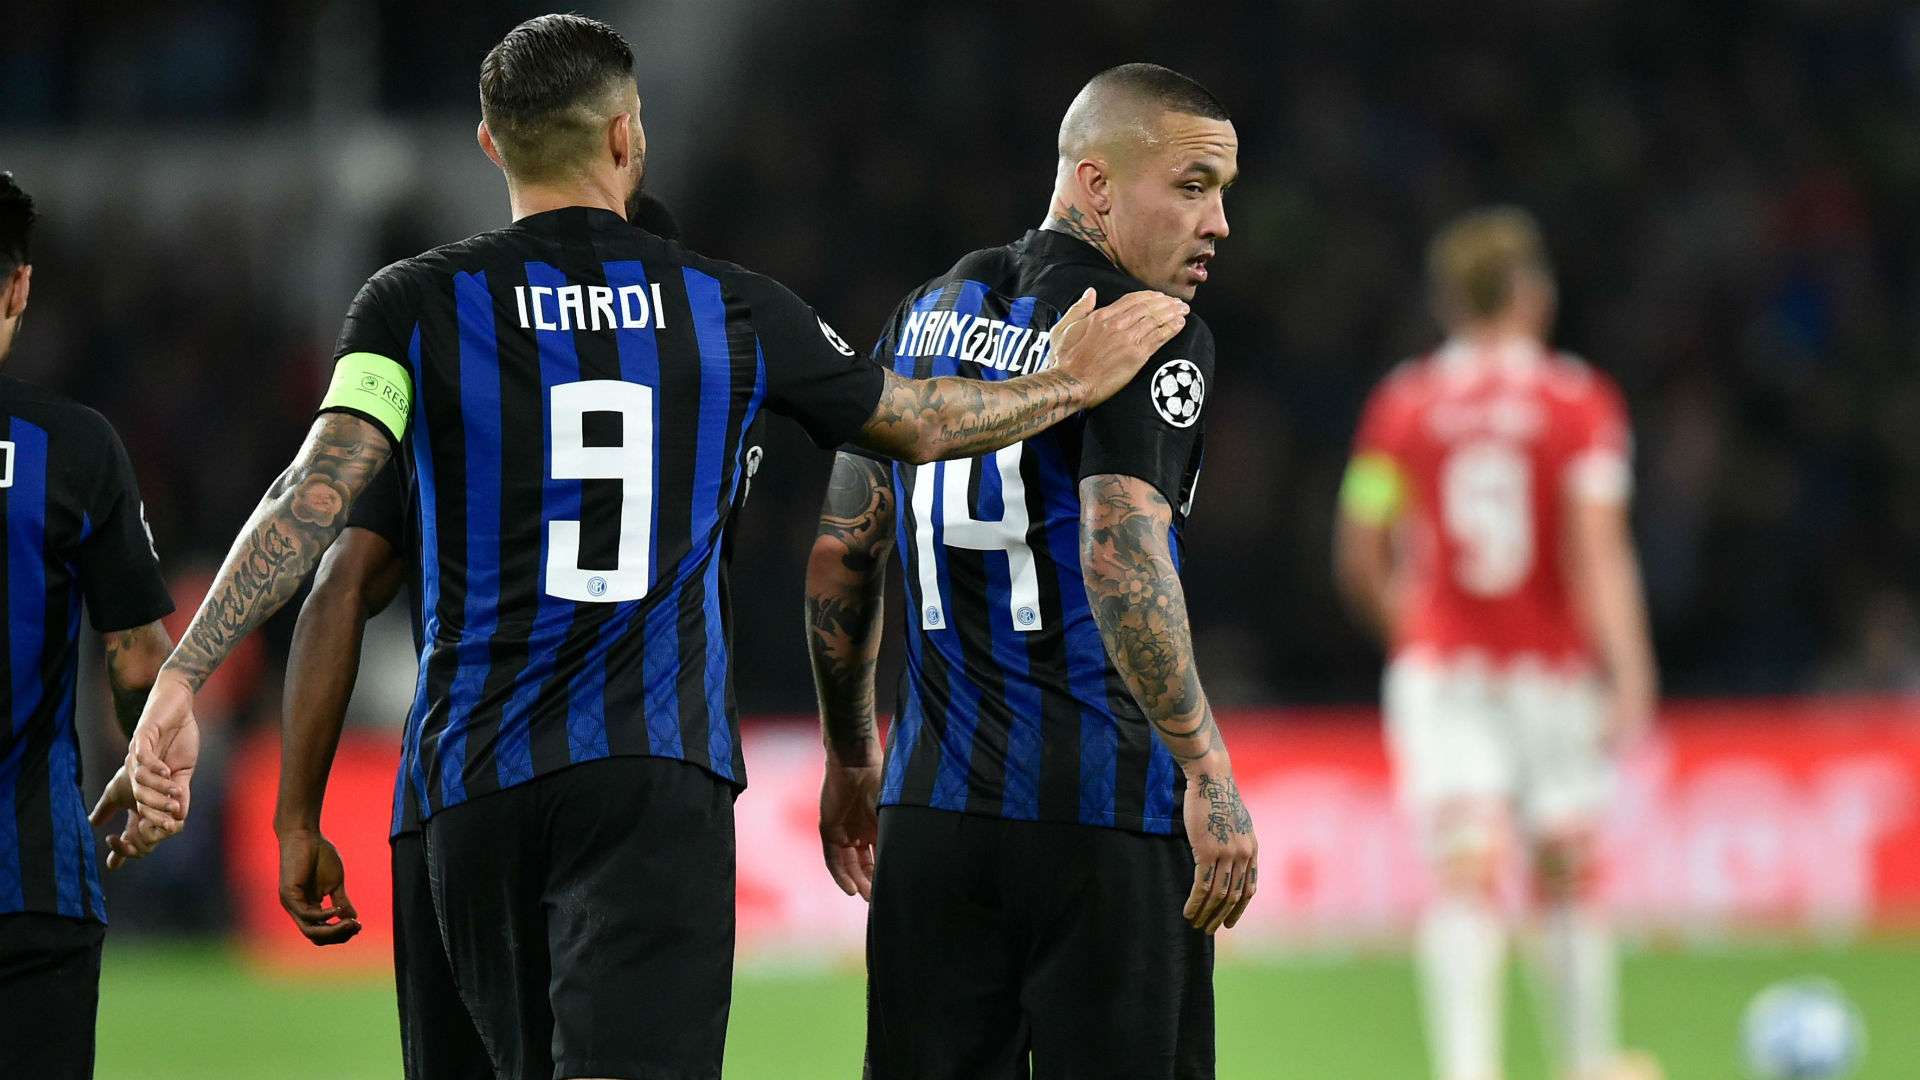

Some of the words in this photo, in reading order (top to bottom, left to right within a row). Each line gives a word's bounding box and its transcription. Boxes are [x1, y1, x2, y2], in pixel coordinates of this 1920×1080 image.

[515, 283, 666, 331] ICARDI
[897, 311, 1050, 374] NAINGGOLA
[545, 380, 653, 603] 9
[912, 441, 1042, 631] 14
